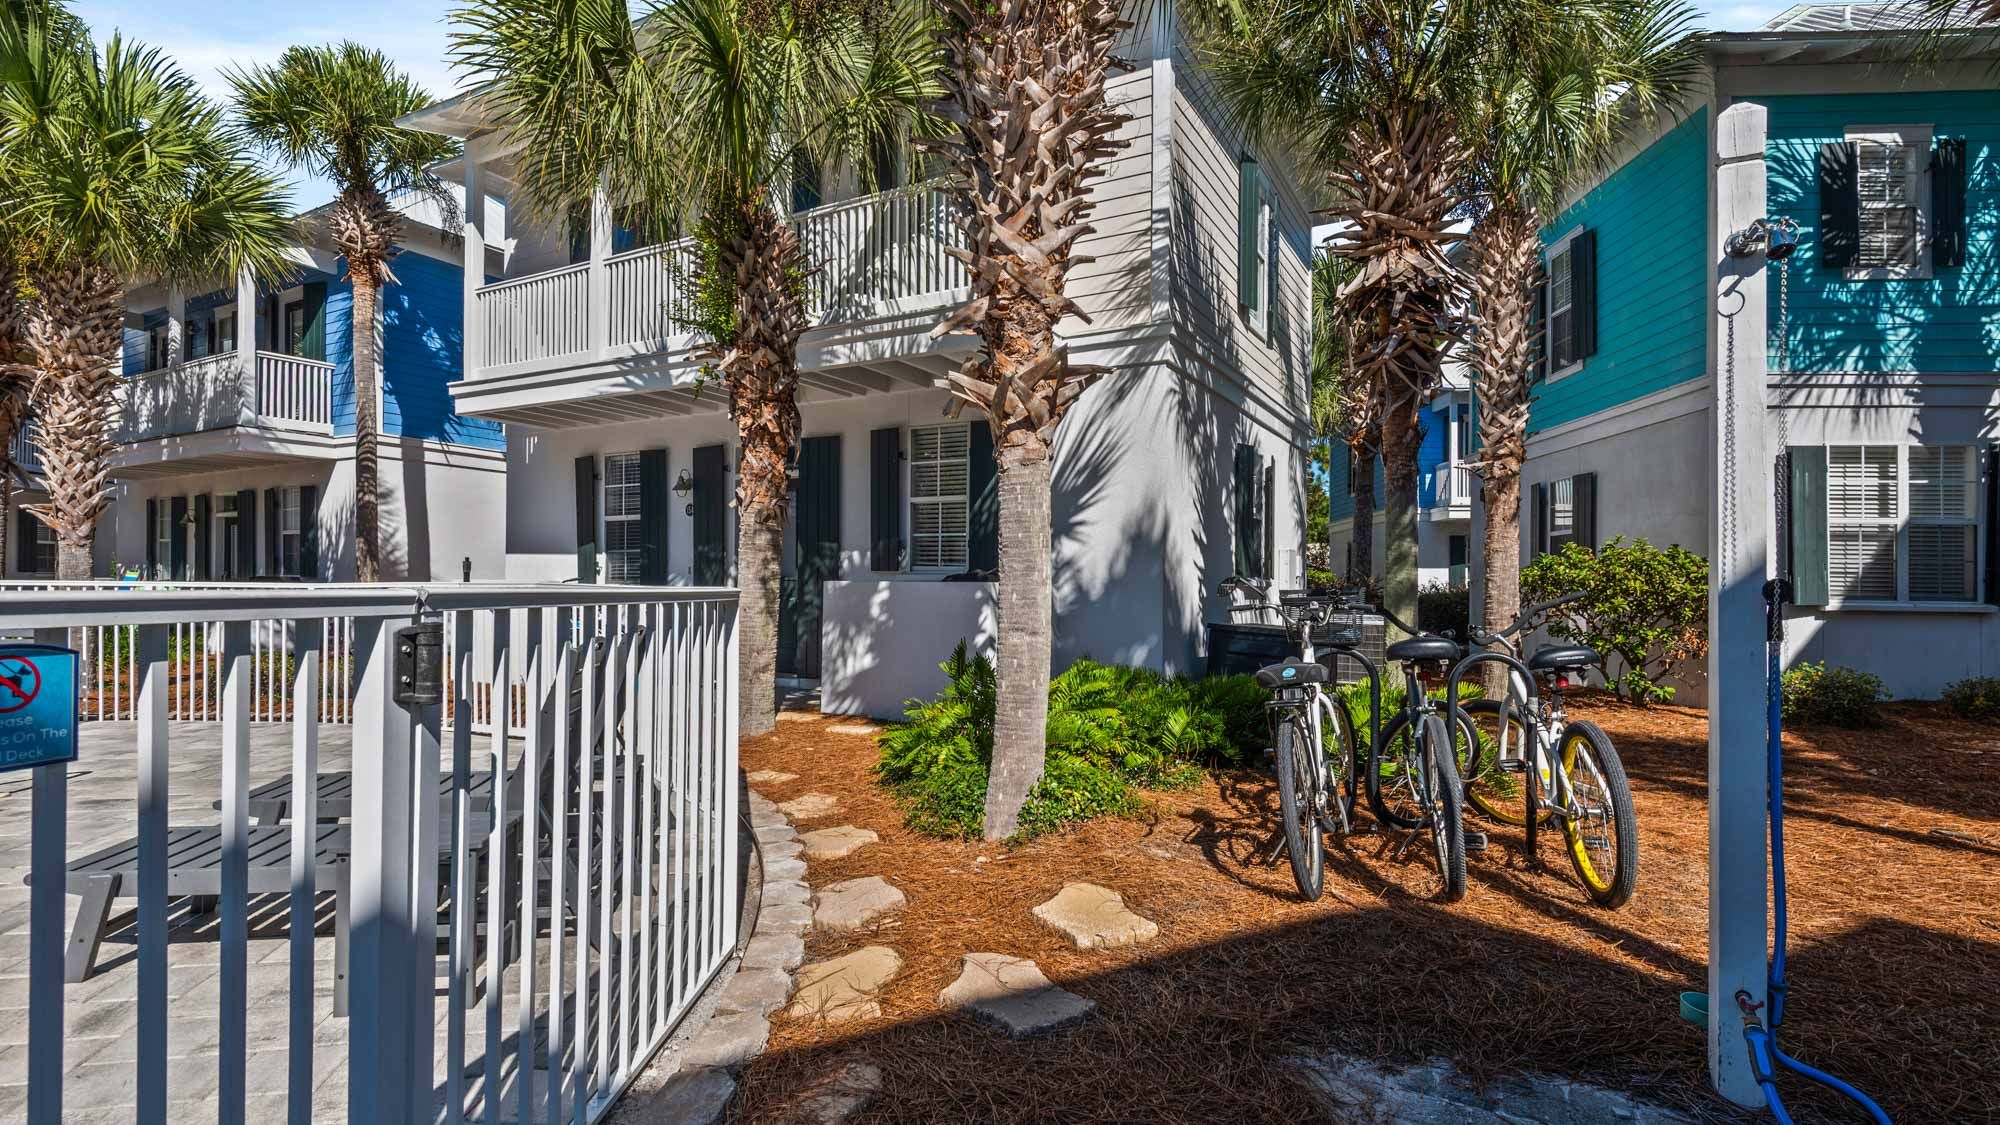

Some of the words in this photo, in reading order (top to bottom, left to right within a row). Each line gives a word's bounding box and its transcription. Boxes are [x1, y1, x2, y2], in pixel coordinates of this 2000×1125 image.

[13, 732, 36, 743] On
[40, 728, 67, 739] The
[7, 746, 43, 761] Deck
